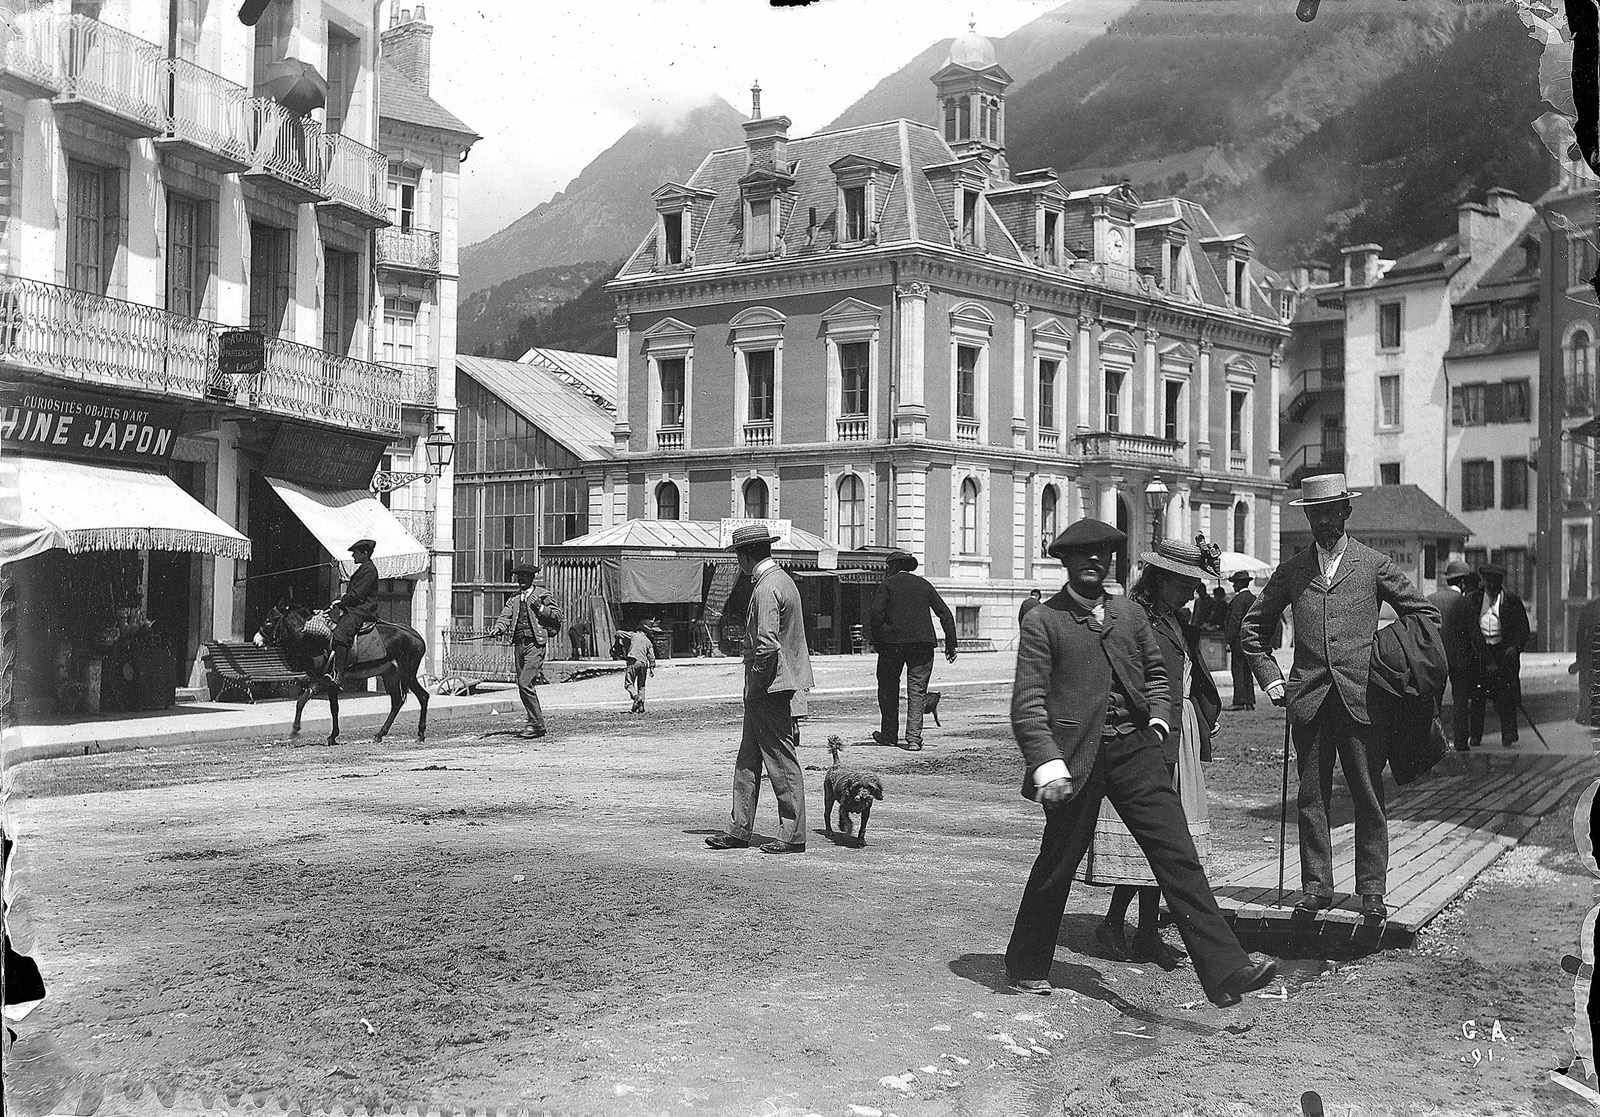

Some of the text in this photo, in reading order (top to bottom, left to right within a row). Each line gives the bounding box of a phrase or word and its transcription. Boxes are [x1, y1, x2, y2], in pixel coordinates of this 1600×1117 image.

[85, 404, 120, 420] OBJETS
[122, 408, 149, 423] D'ART
[82, 419, 172, 456] JAPON
